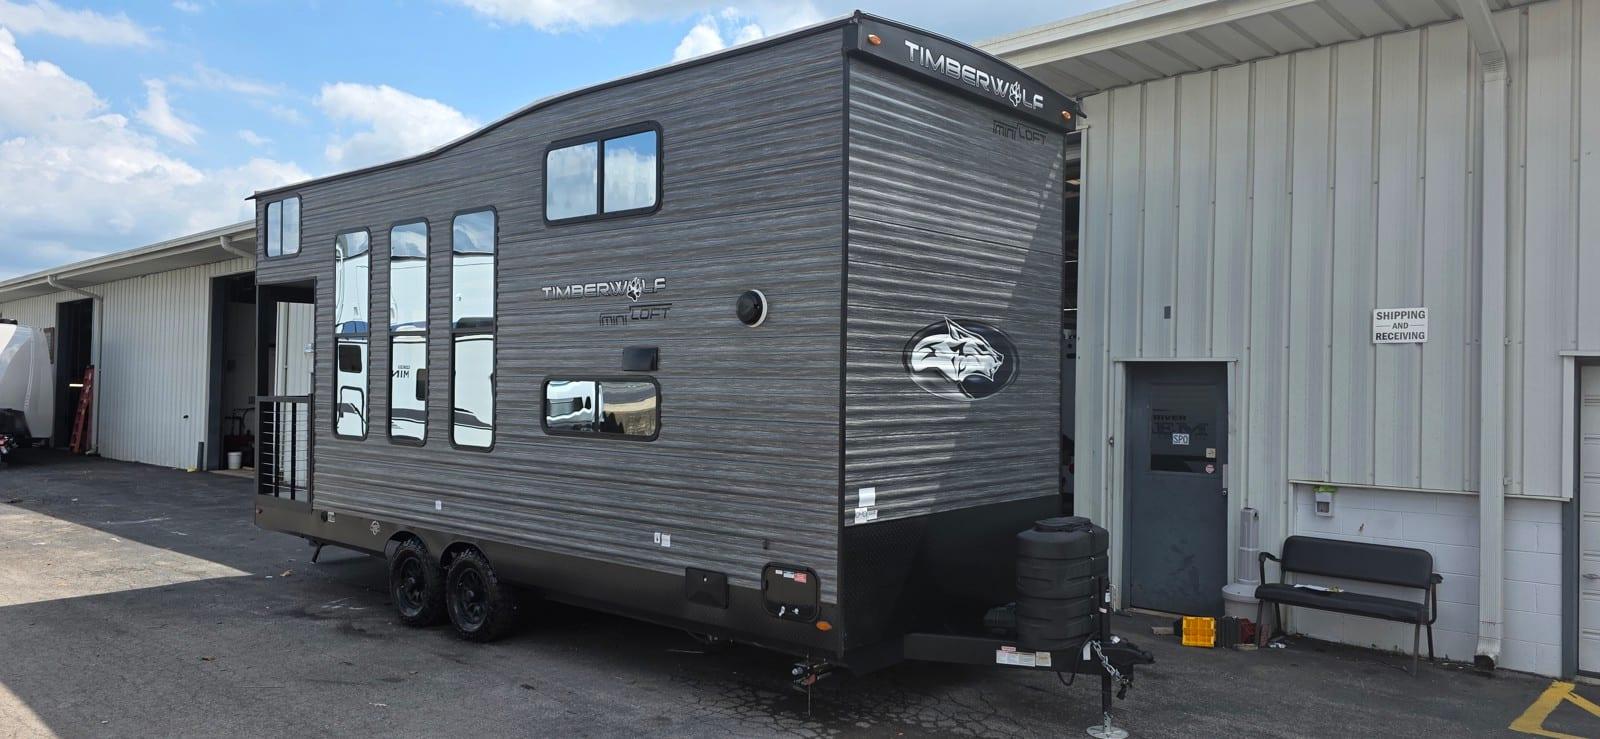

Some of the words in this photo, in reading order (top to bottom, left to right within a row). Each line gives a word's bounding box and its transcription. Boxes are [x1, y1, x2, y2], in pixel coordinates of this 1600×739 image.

[905, 40, 1044, 110] TIMBERWOLF
[1018, 126, 1048, 145] LOFT
[541, 277, 666, 302] TIMBERWOLF
[630, 306, 672, 320] LOFT
[1376, 310, 1426, 320] SHIPPING
[1375, 331, 1425, 341] RECEIVING
